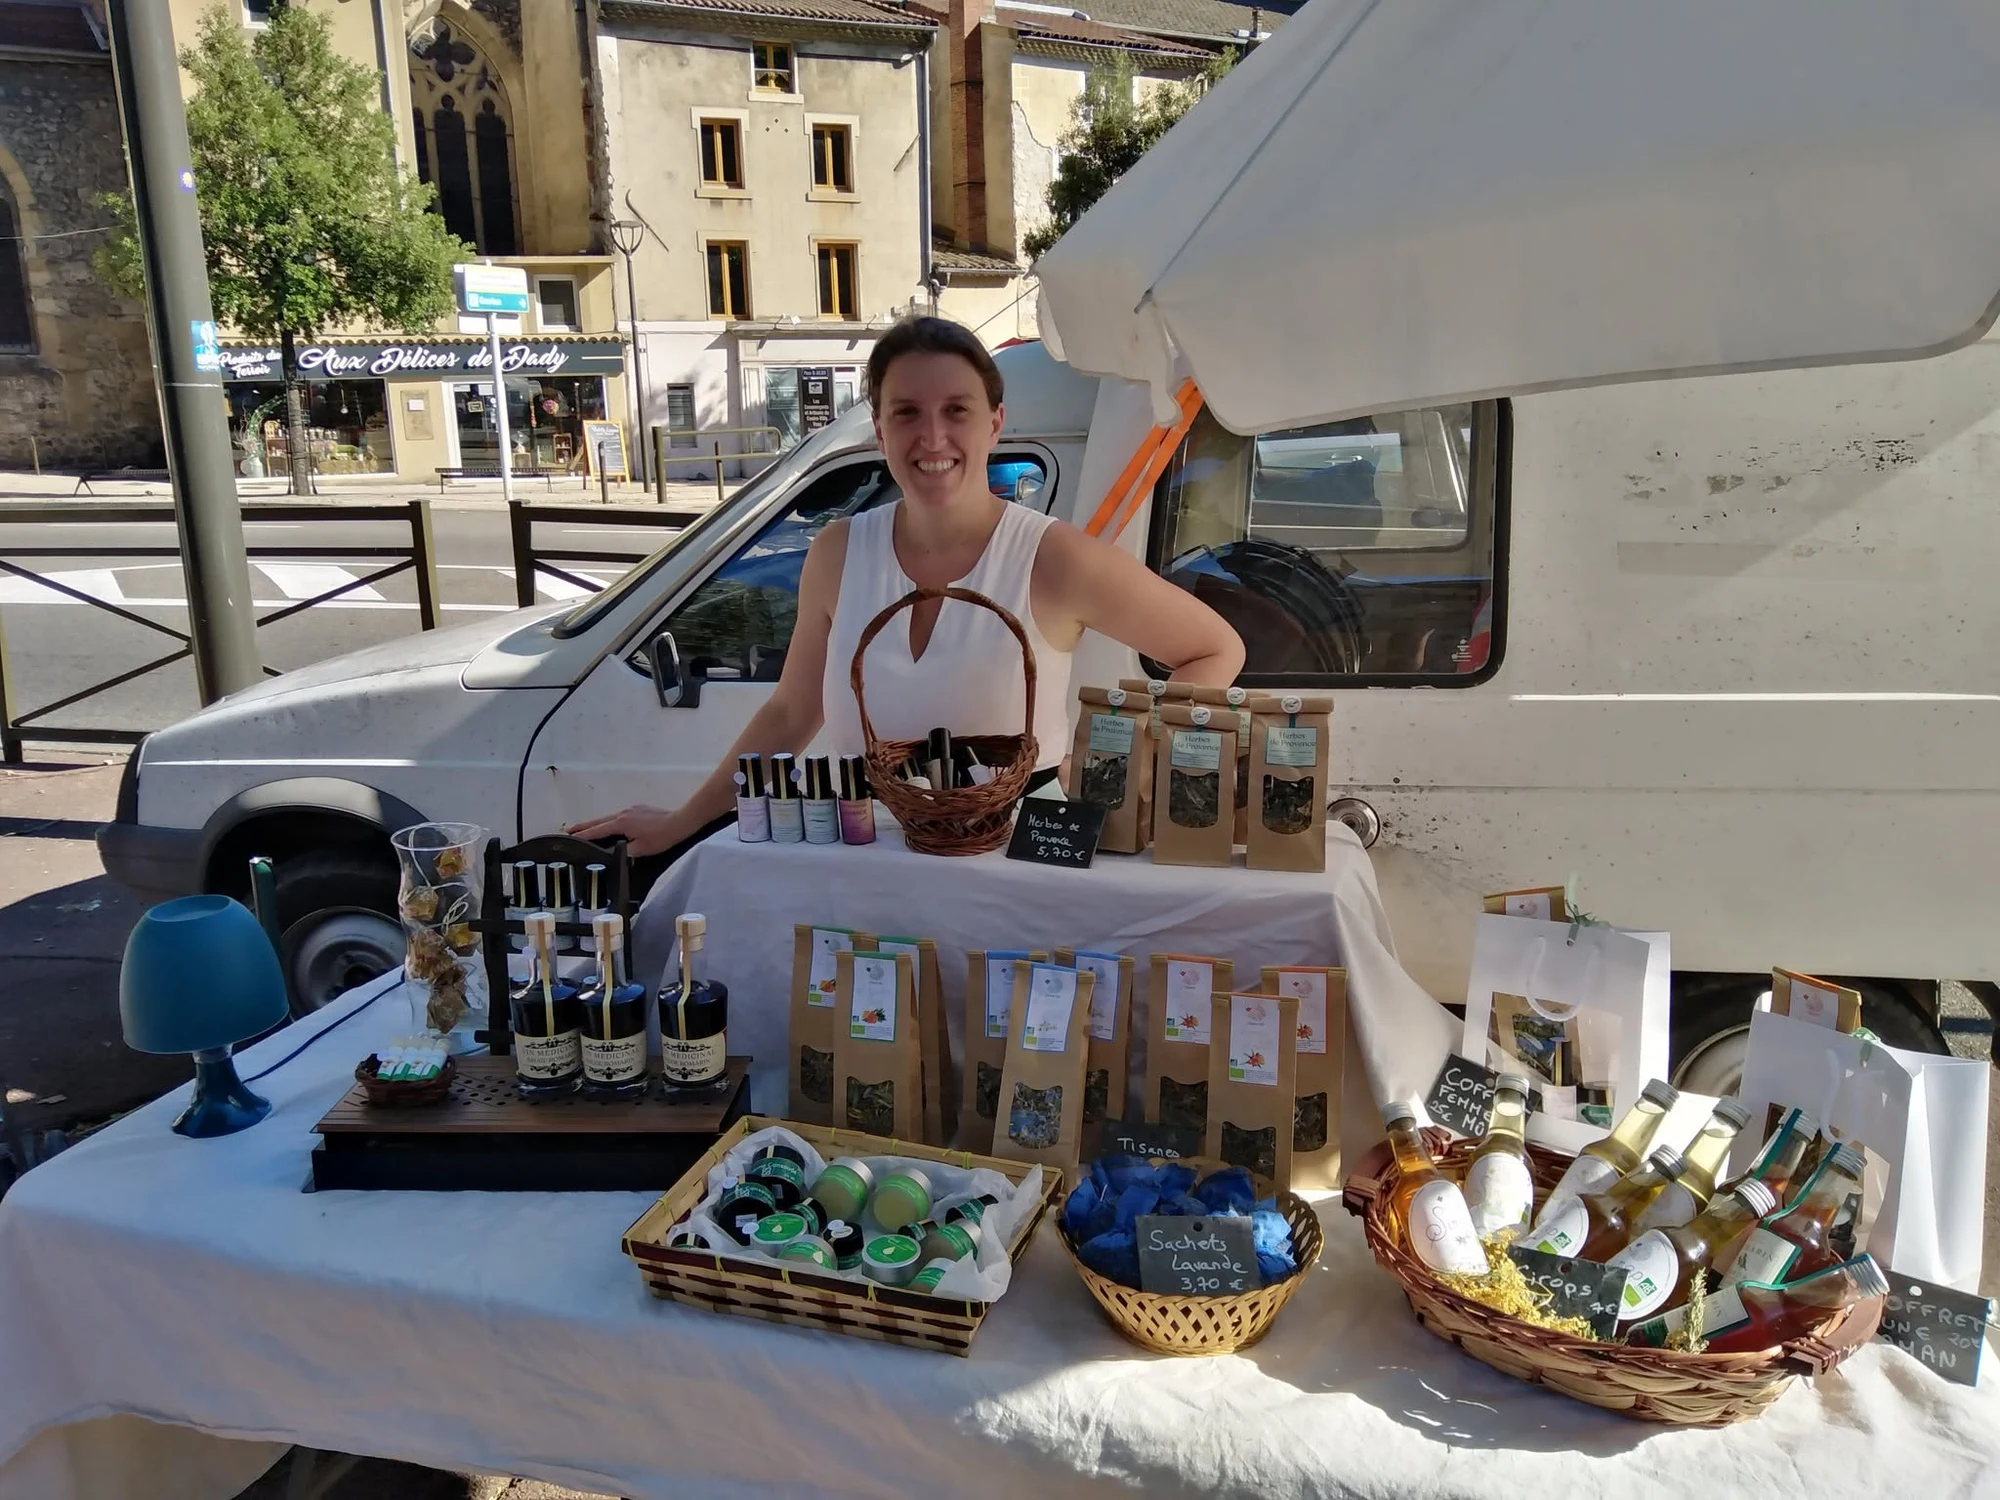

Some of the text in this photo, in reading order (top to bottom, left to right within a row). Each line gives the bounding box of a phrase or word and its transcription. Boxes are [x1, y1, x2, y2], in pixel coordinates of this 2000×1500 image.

[218, 351, 264, 368] Produits
[299, 344, 570, 376] Aux Délices de Dady
[233, 362, 271, 379] Terroir
[1101, 717, 1125, 728] Herbes
[1101, 725, 1133, 736] Provence
[1185, 735, 1211, 743] Herbes
[1279, 731, 1306, 739] Herbes
[1281, 739, 1316, 747] Provence
[1186, 742, 1220, 751] Provence
[1028, 813, 1081, 832] Herbes de
[1030, 829, 1074, 847] Provence
[538, 1043, 575, 1057] MEDICIN
[1116, 1137, 1181, 1158] Tisanes
[1148, 1229, 1227, 1252] Sachets
[1171, 1253, 1249, 1274] Lavande
[1180, 1276, 1220, 1294] 3,70
[1589, 1301, 1618, 1315] 7€
[1885, 1295, 1985, 1332] OFFRET
[1881, 1316, 1931, 1340] UNE
